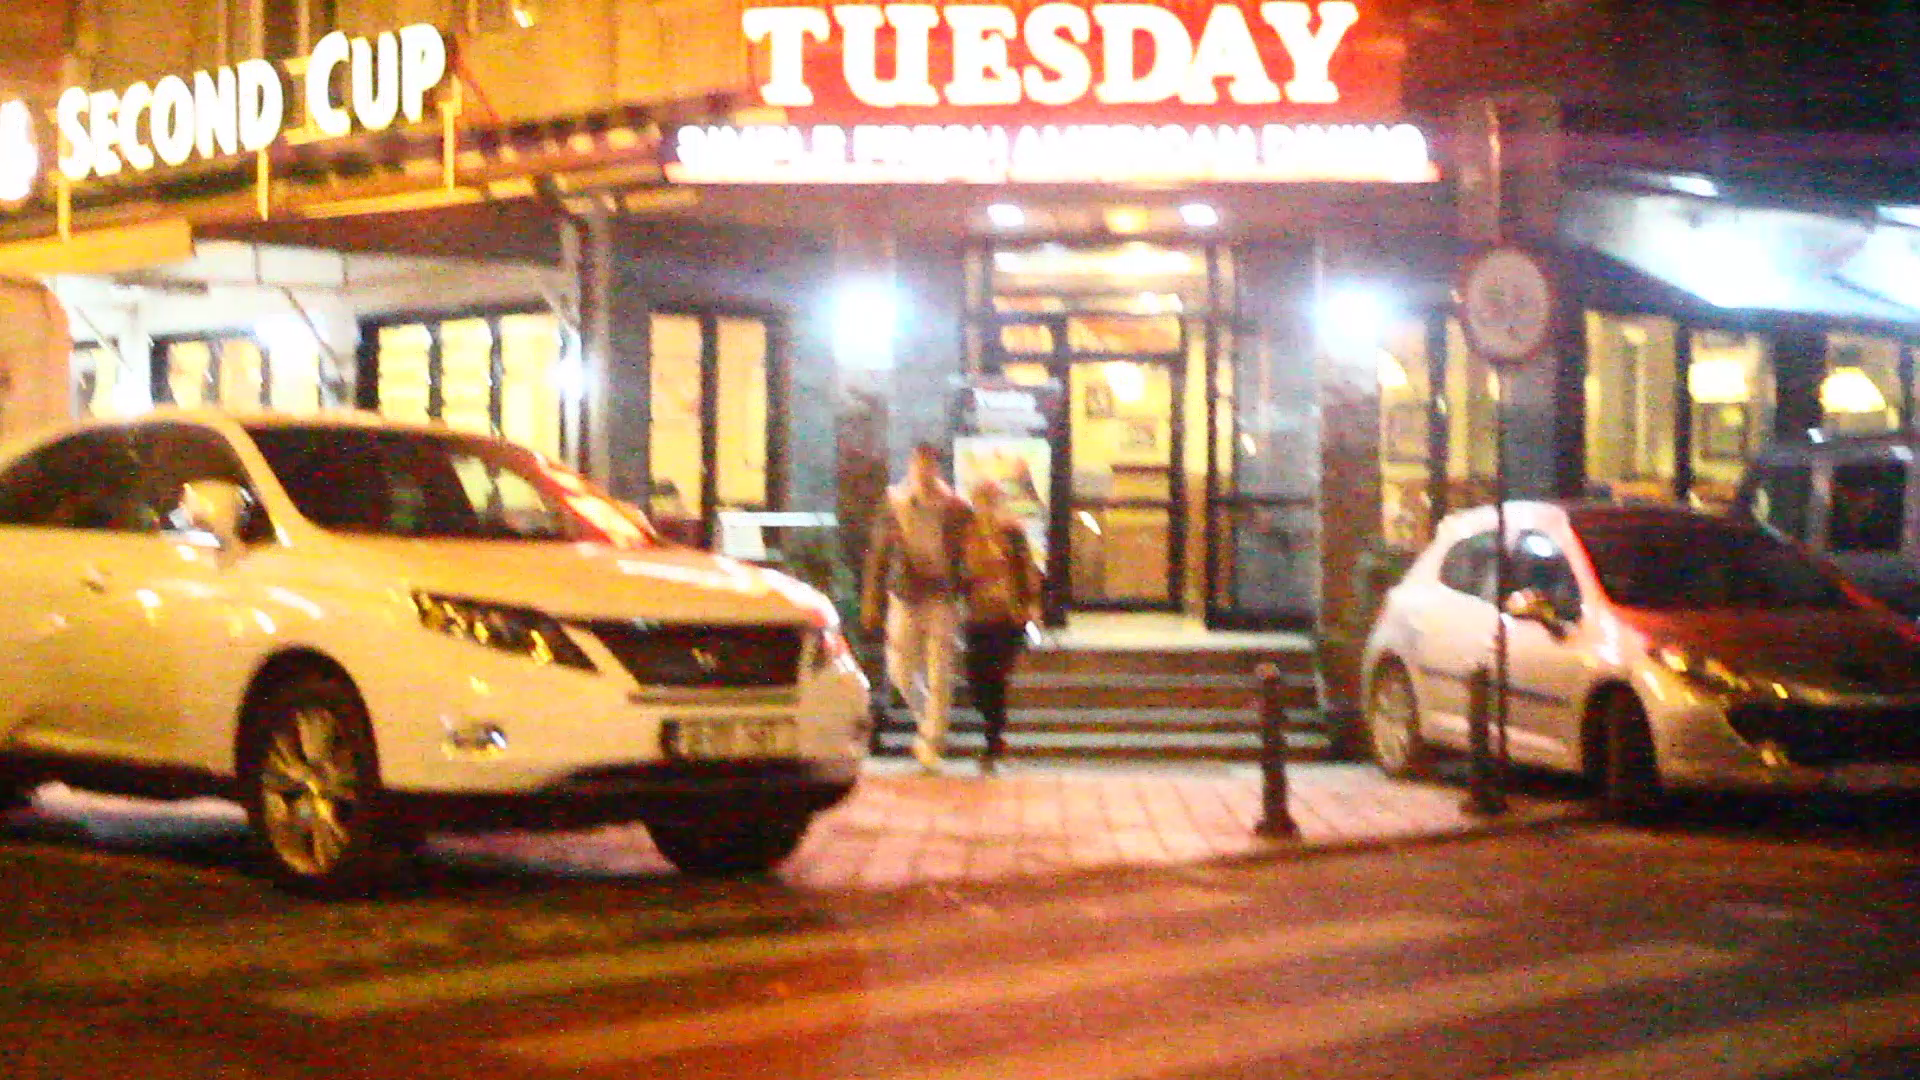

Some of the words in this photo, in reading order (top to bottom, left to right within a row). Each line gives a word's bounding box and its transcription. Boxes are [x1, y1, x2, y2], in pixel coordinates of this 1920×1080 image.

[57, 60, 283, 179] SECOND
[305, 24, 446, 135] CUP
[742, 2, 1358, 106] TUESDAY
